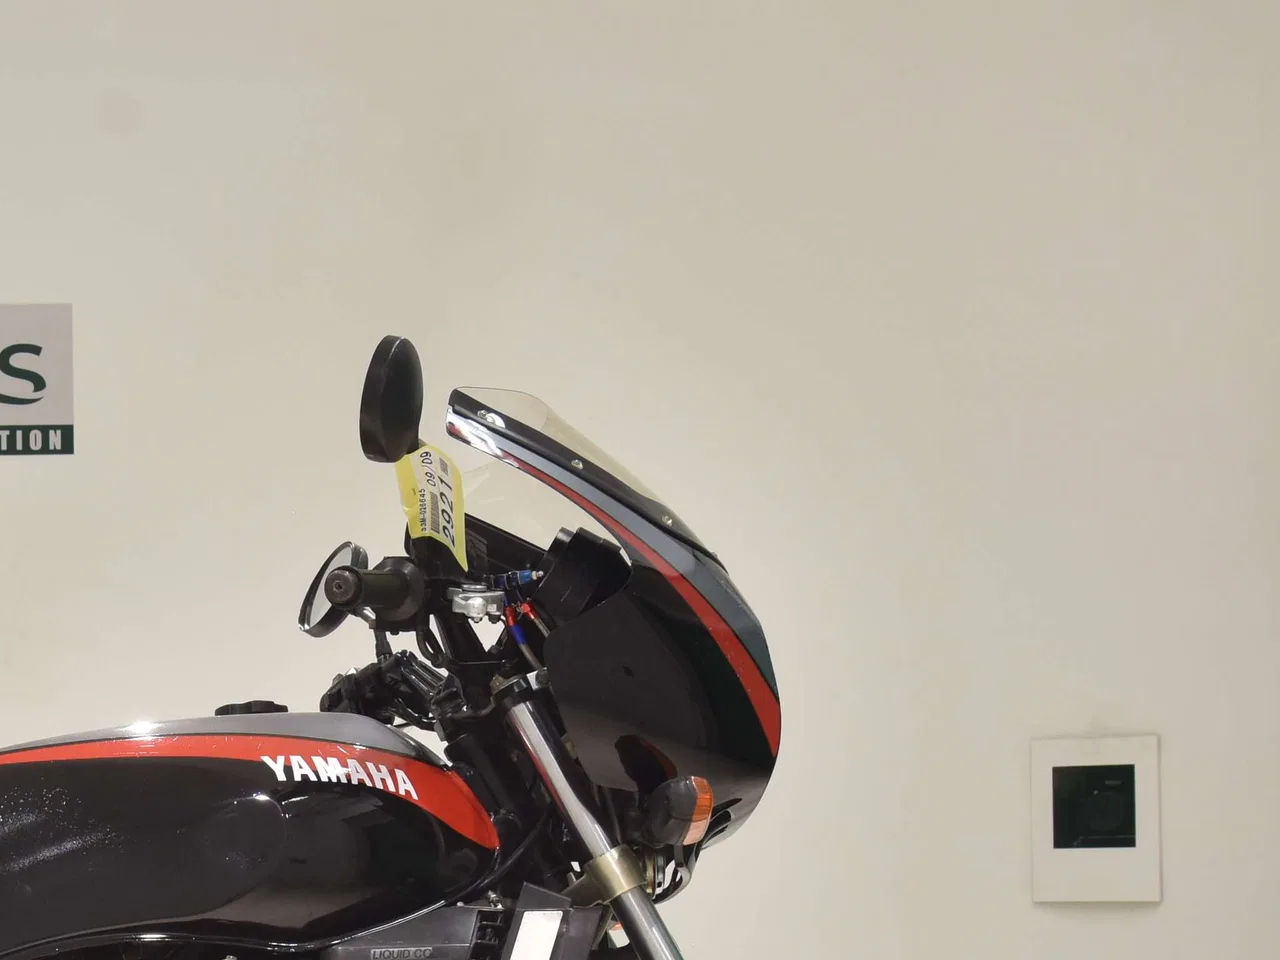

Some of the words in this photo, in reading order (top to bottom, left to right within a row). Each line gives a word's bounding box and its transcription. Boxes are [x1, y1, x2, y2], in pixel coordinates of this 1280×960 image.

[420, 451, 436, 487] 09/09
[437, 475, 455, 548] 2921
[260, 755, 419, 801] YAMAHA
[372, 949, 411, 960] LIQUID
